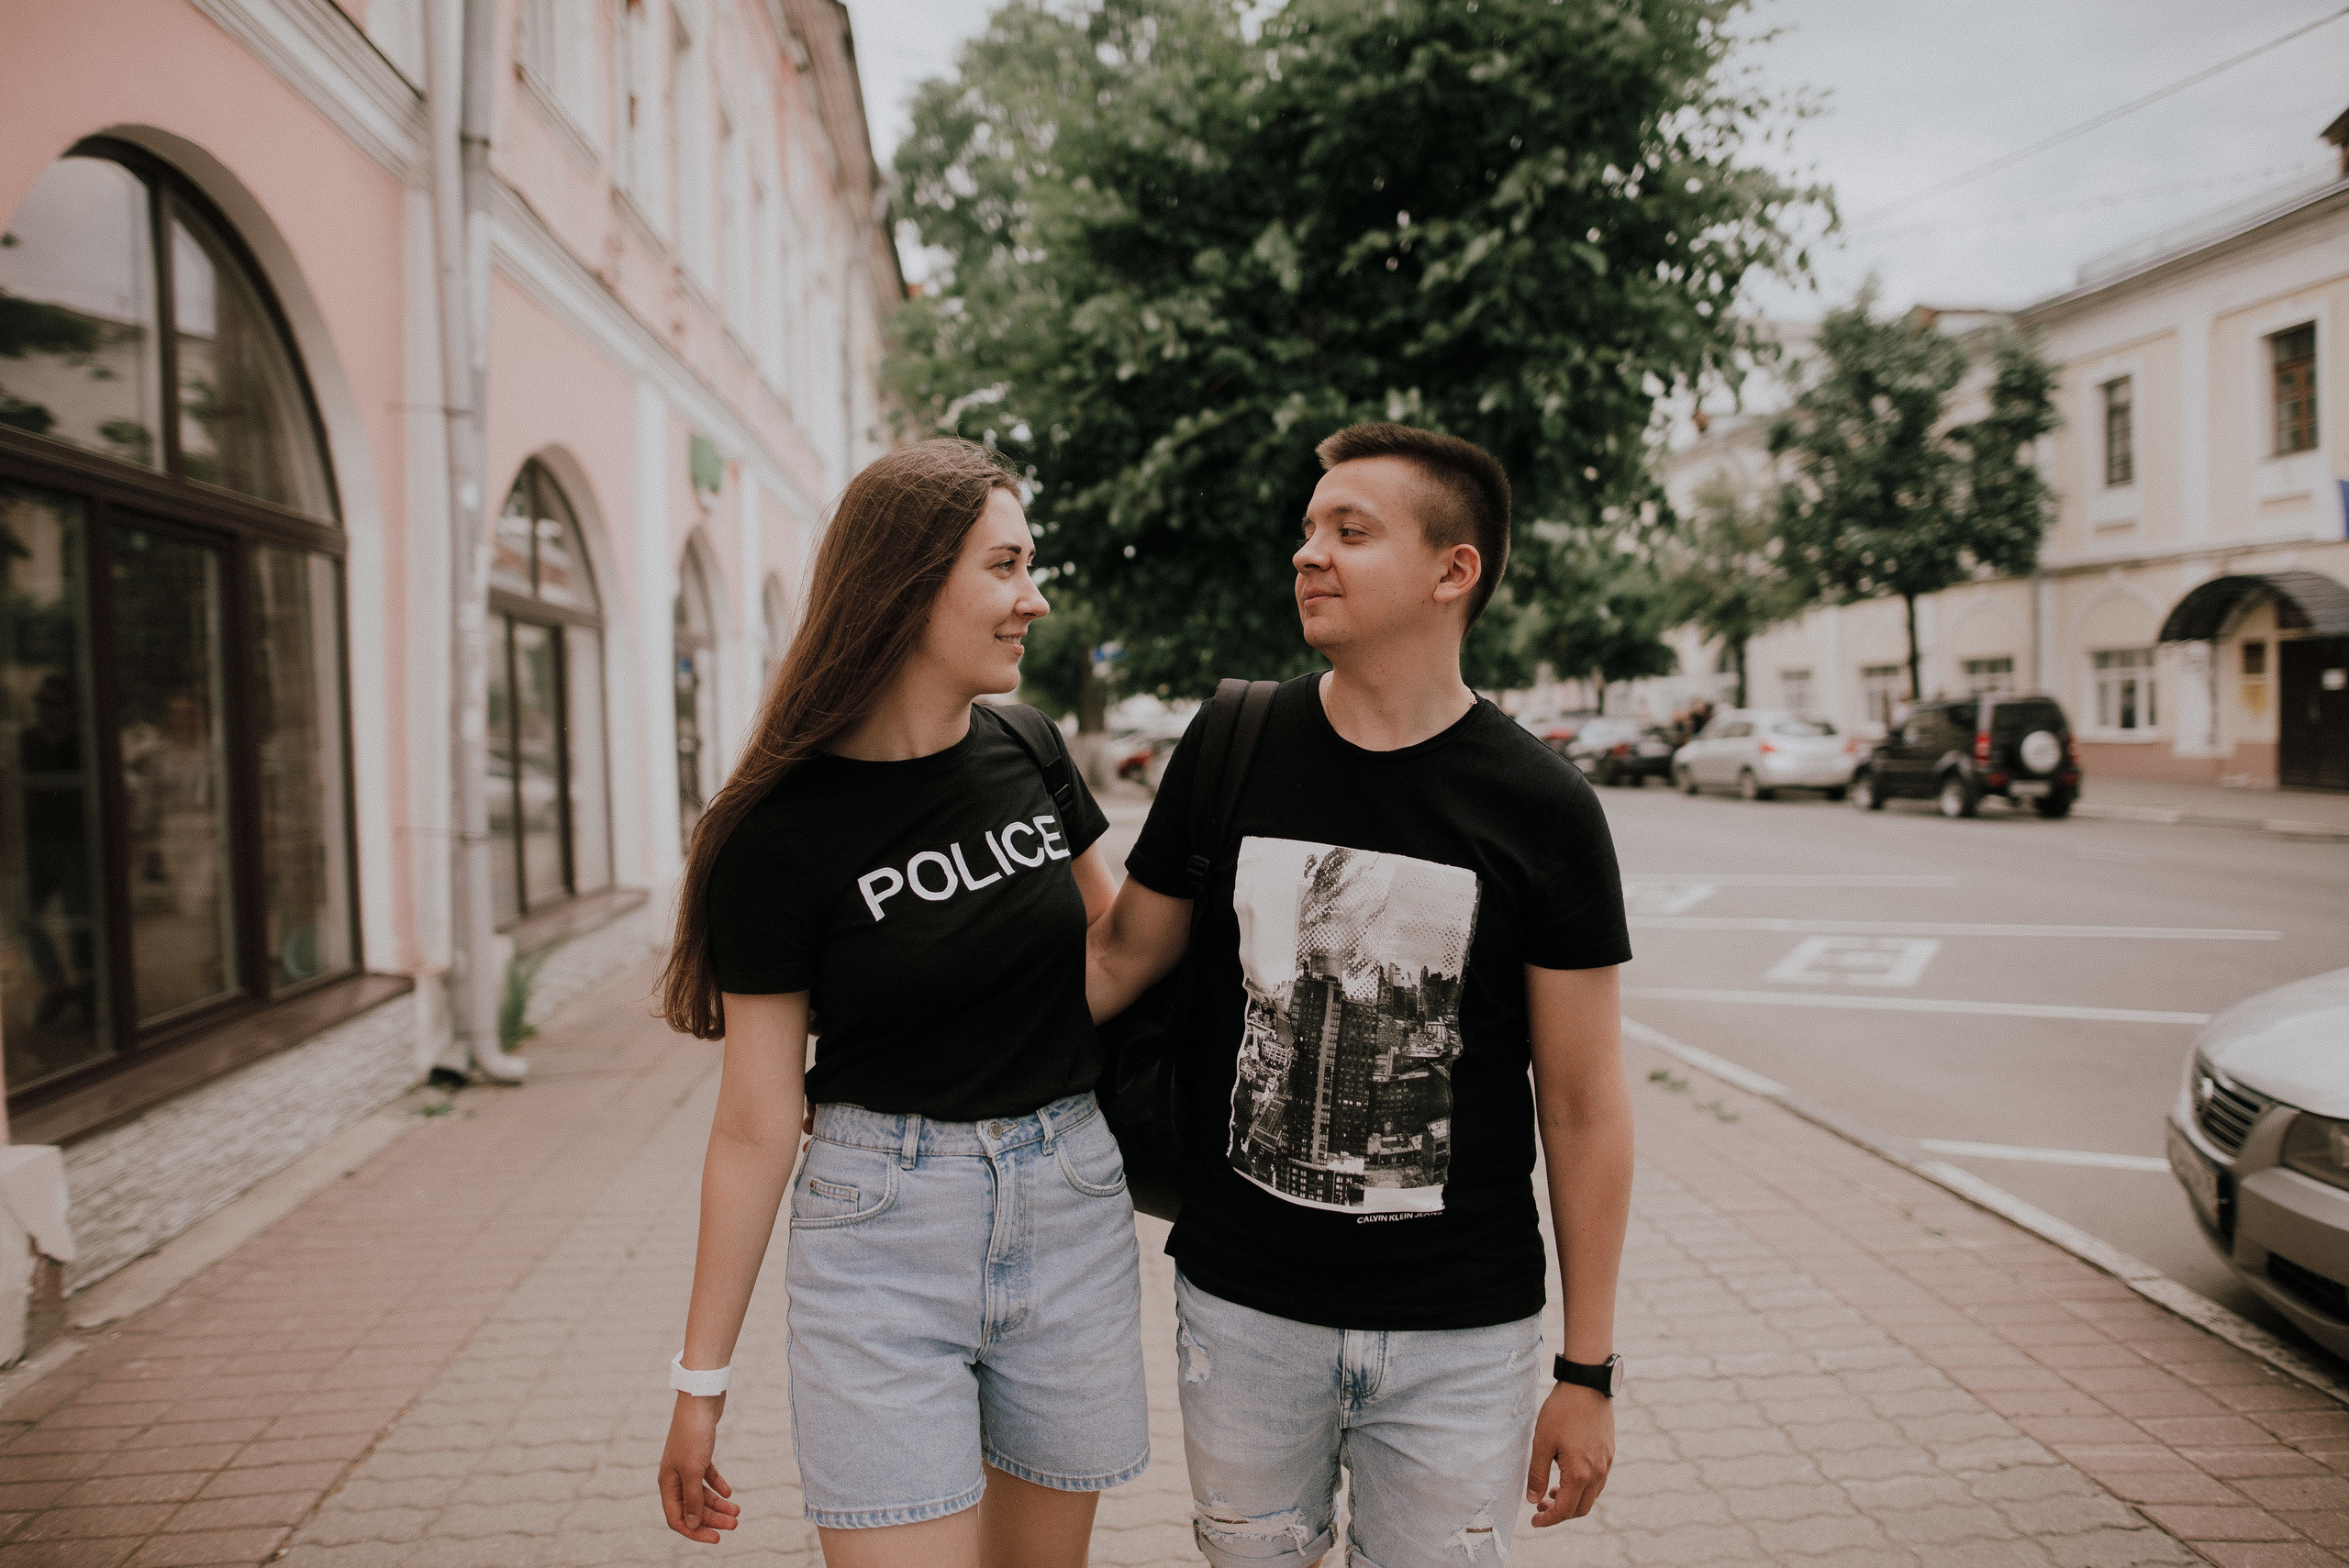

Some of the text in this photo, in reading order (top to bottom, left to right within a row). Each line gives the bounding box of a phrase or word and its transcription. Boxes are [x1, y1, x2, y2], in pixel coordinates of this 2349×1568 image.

[857, 815, 1071, 921] POLICE
[1356, 1215, 1387, 1224] CALVIN
[1388, 1213, 1414, 1222] KLEIN
